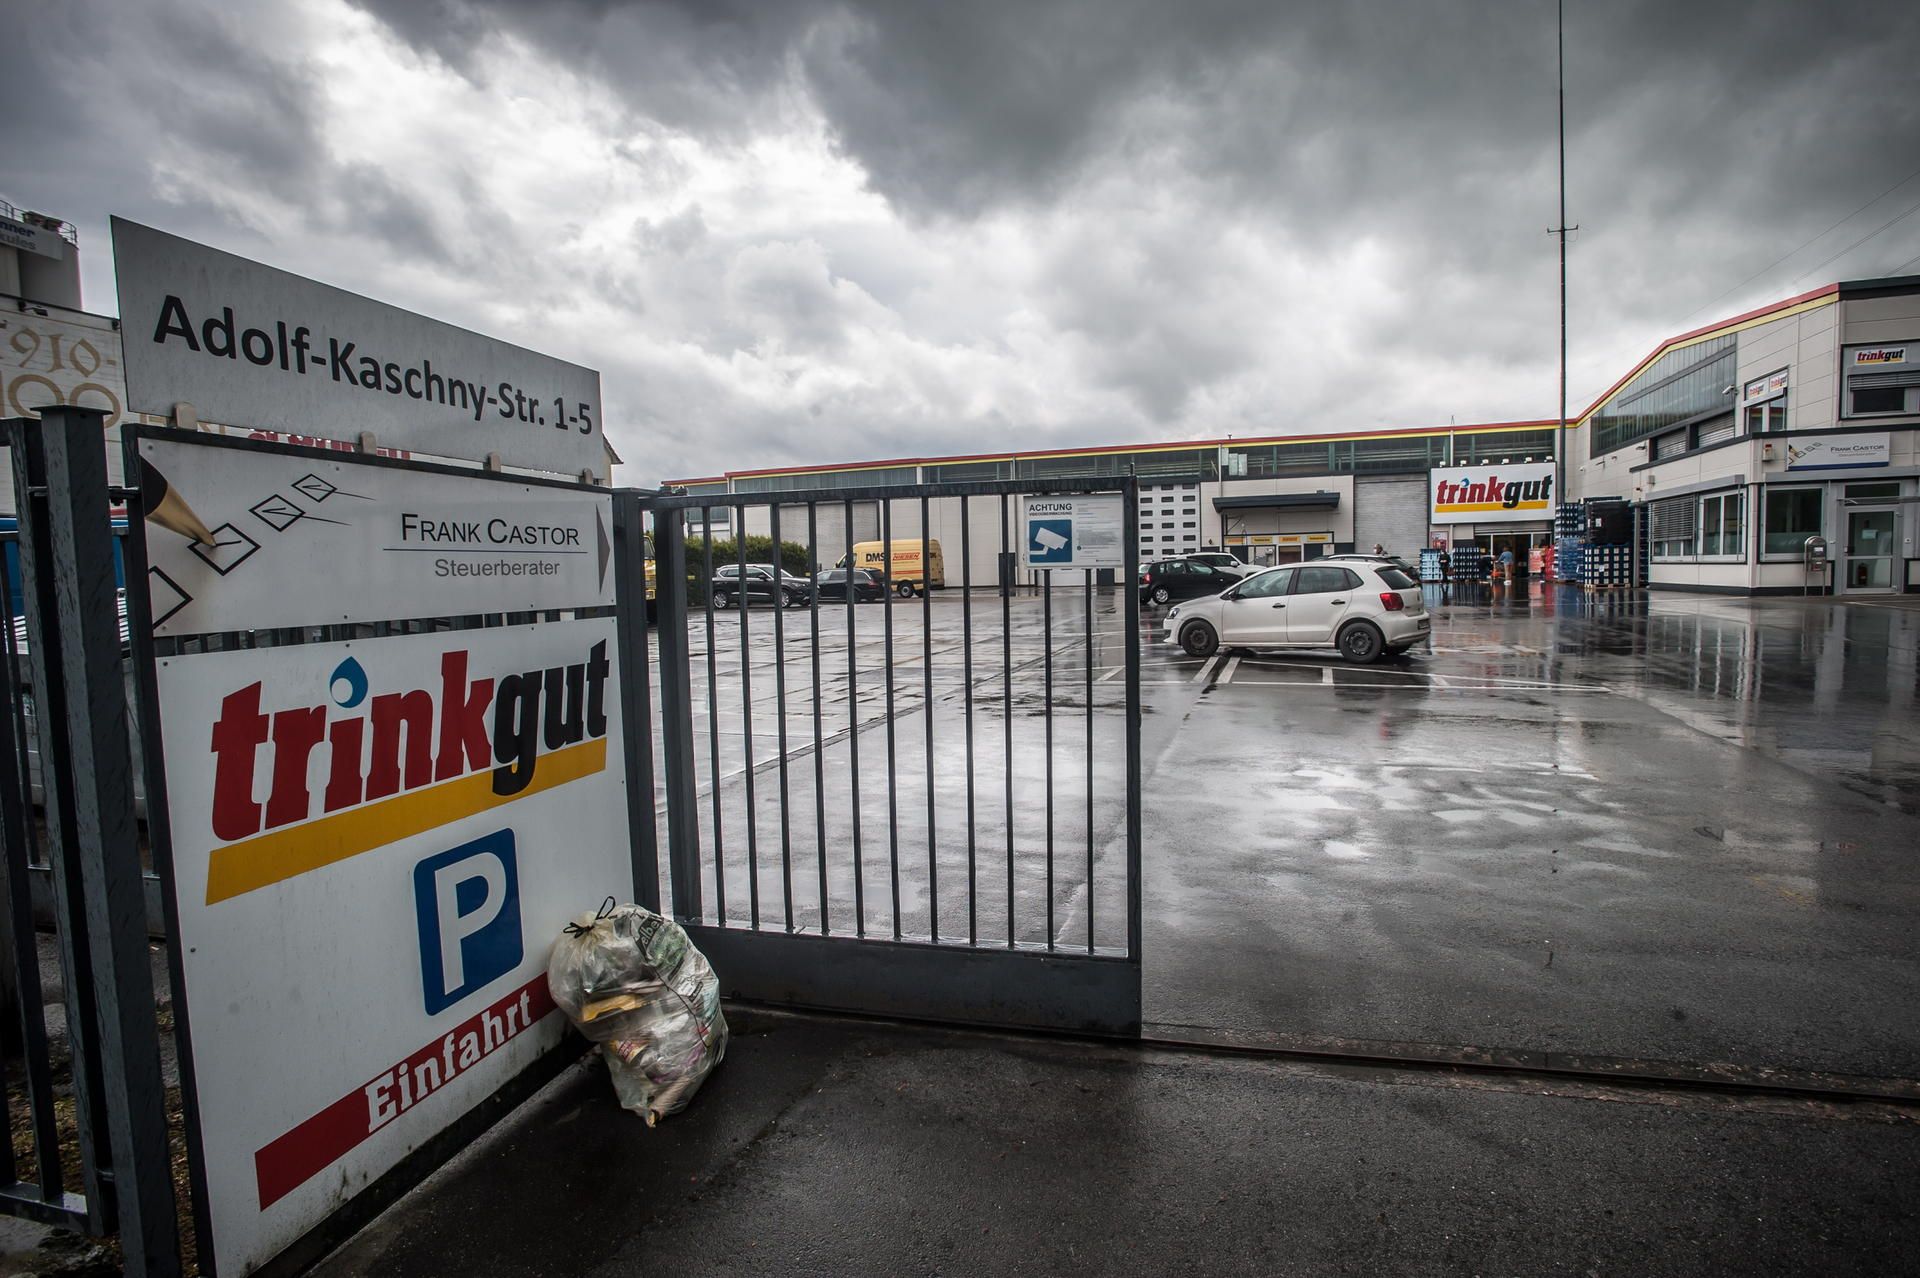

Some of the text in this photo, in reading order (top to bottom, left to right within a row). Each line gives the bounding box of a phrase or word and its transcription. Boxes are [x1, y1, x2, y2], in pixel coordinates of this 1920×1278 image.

[153, 294, 593, 435] Adolf-Kaschny-Str. 1-5
[1857, 349, 1904, 361] trinkgut
[1029, 503, 1072, 512] ACHTUNG
[1437, 474, 1553, 508] trinkgut
[401, 513, 580, 547] FRANK CASTOR
[434, 558, 560, 578] Steuerberater
[211, 638, 610, 842] trinkgut
[435, 852, 508, 995] P
[365, 990, 532, 1134] Einfahrt
